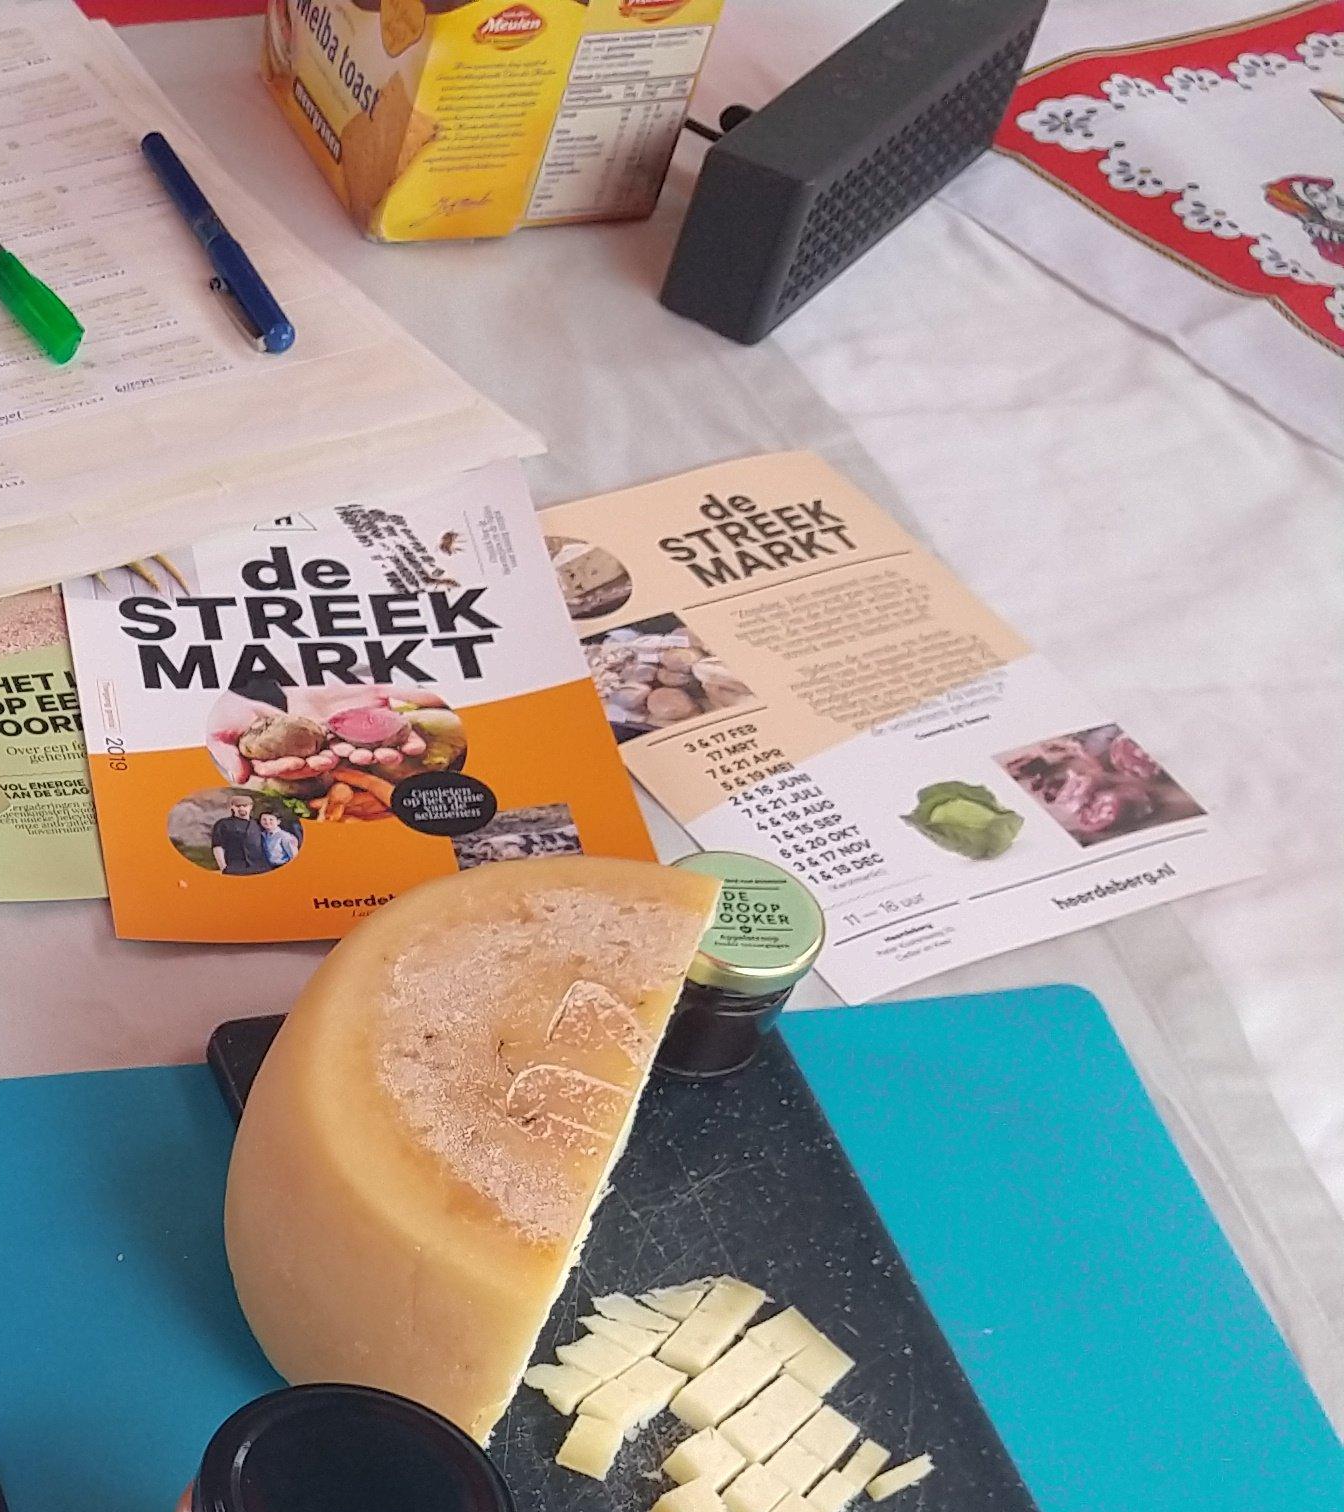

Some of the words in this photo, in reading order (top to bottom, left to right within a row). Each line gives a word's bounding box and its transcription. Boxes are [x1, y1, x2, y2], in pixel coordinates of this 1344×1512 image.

[339, 44, 380, 122] toast
[658, 499, 845, 562] STREEK
[699, 493, 757, 521] de
[241, 546, 351, 591] de
[687, 525, 857, 589] MARKT
[119, 587, 503, 641] STREEK
[137, 635, 494, 689] MARKT
[106, 737, 128, 771] 2019
[723, 891, 749, 902] DE
